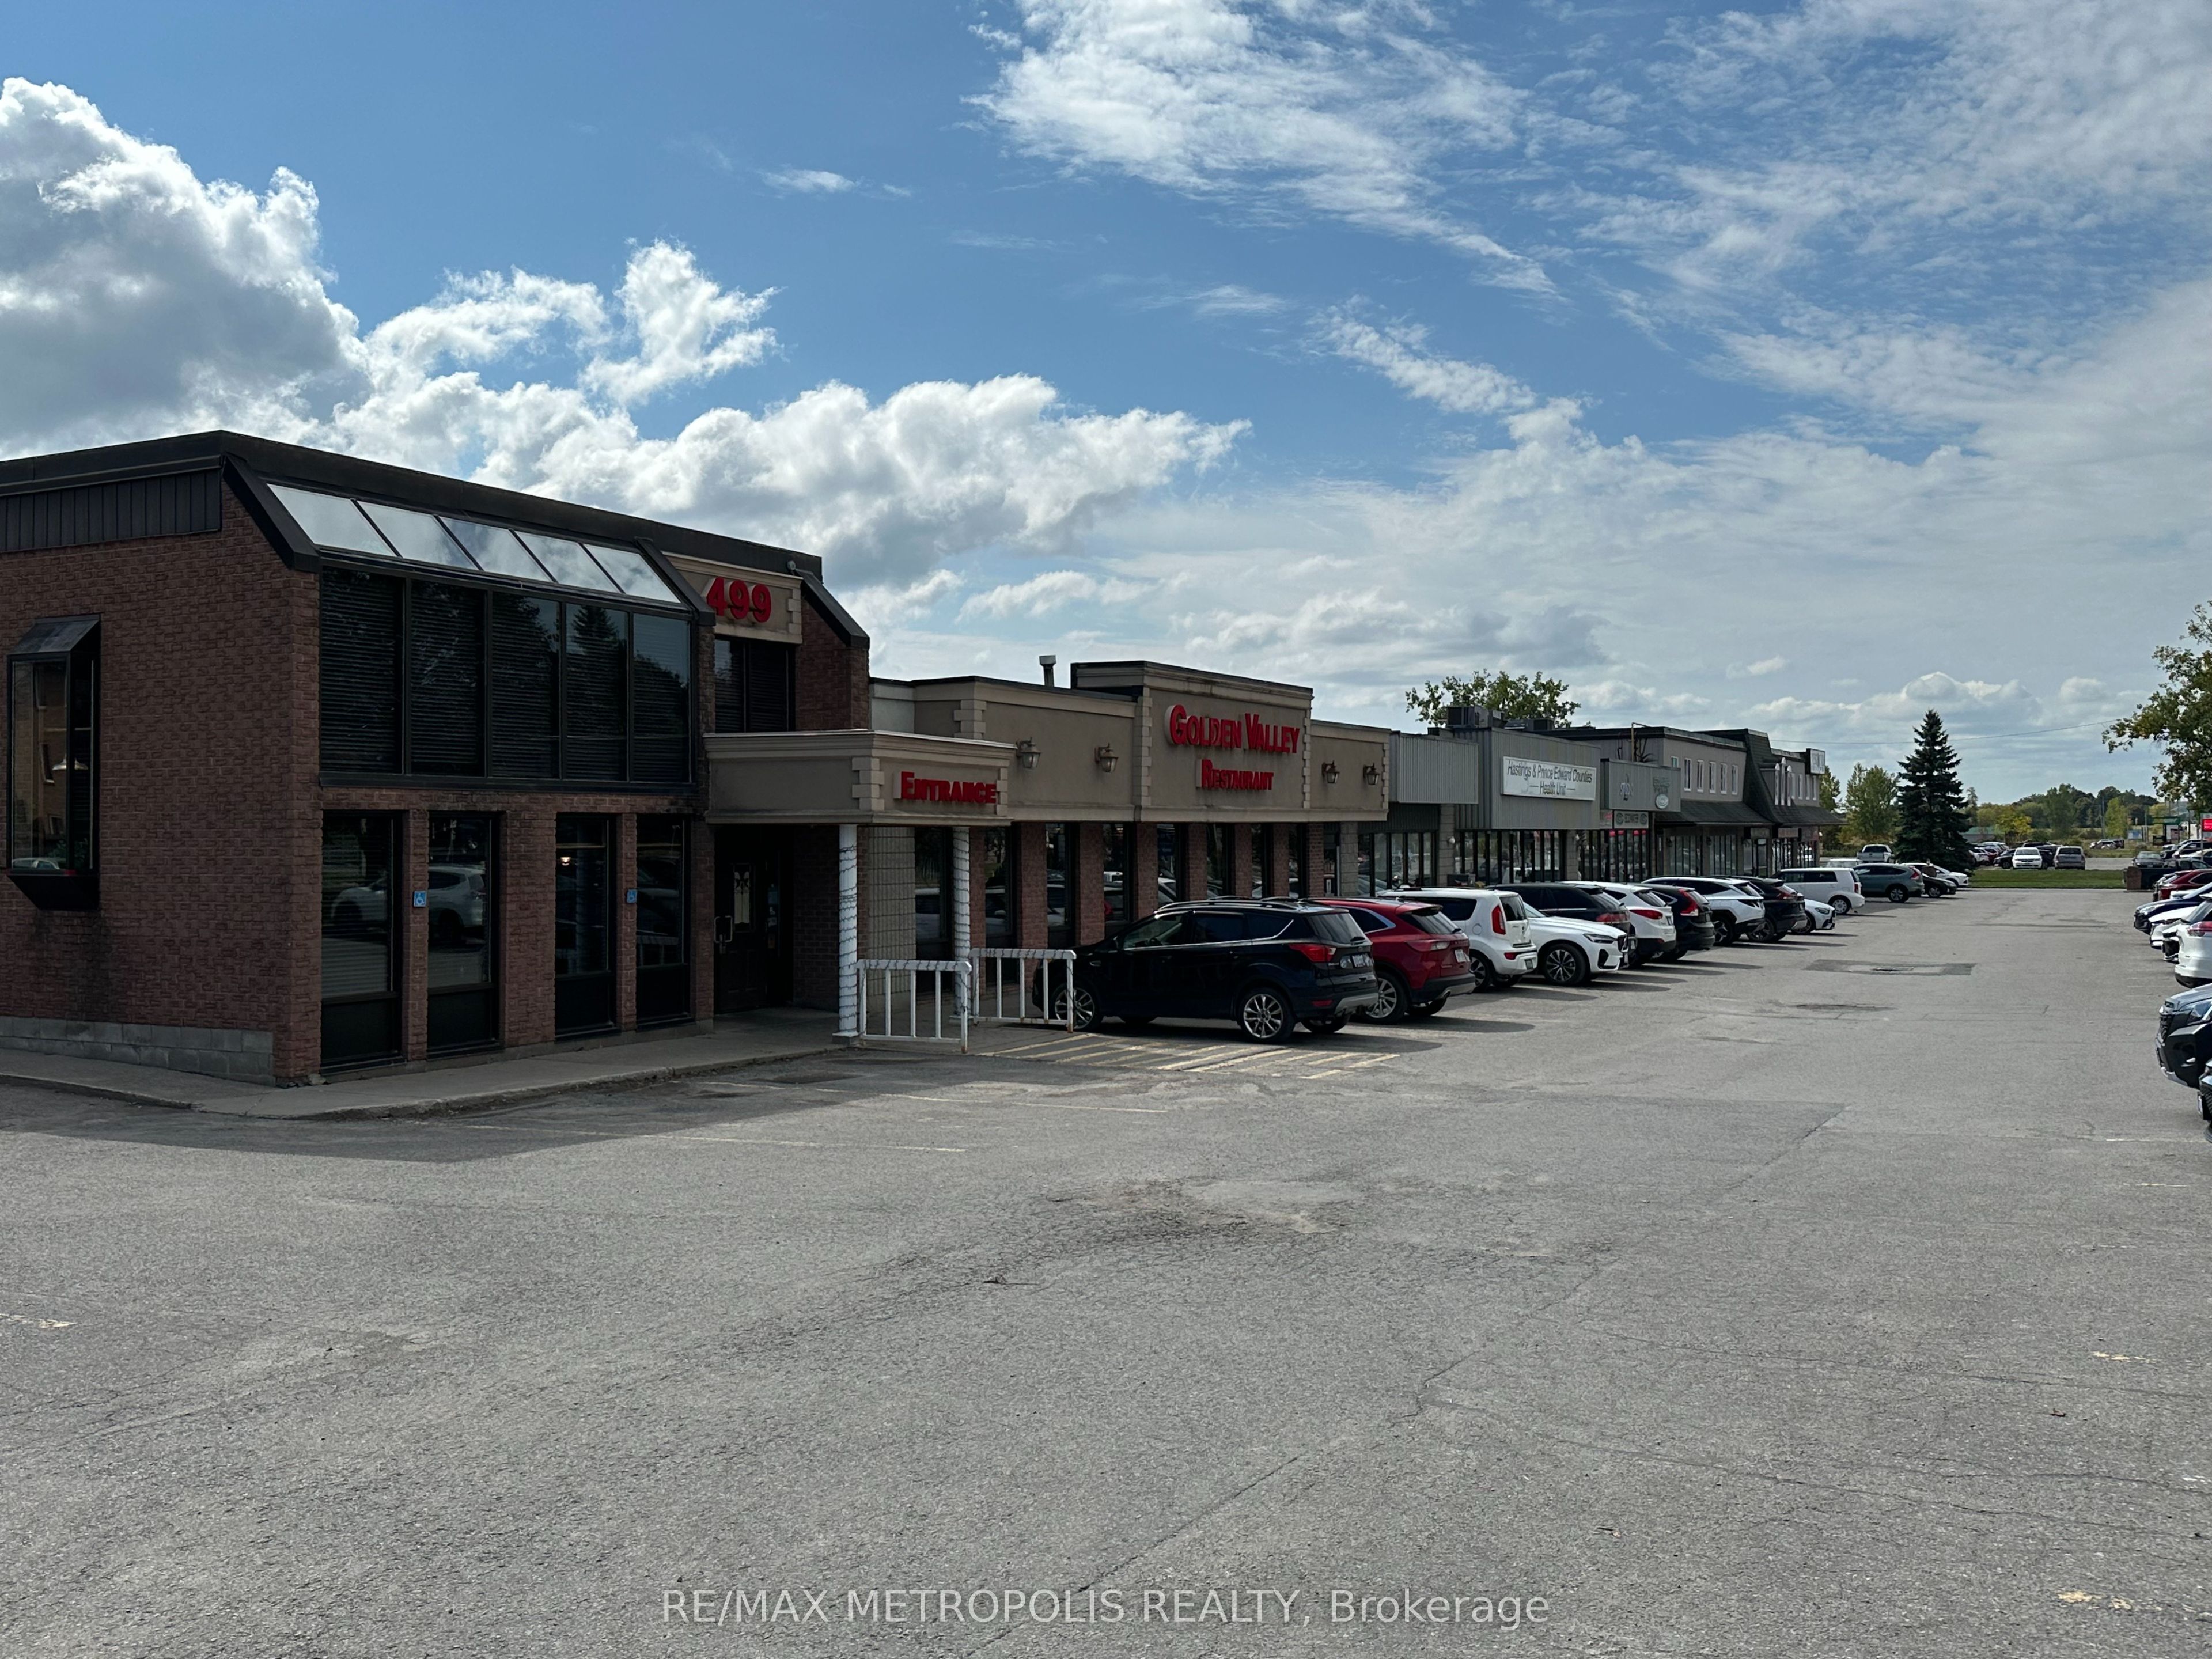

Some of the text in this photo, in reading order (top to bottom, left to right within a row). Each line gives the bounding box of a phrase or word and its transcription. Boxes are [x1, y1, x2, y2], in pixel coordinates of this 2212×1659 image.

[706, 577, 772, 623] 499
[1169, 704, 1300, 753] GOLDEN VALLEY
[1201, 759, 1274, 790] RESTAURANT
[1508, 760, 1532, 781] Hastings
[1533, 764, 1536, 778] &
[1537, 764, 1554, 779] Prince
[1554, 766, 1572, 781] Edward
[900, 771, 997, 804] ENTRANCE
[1540, 780, 1566, 796] Health Unit
